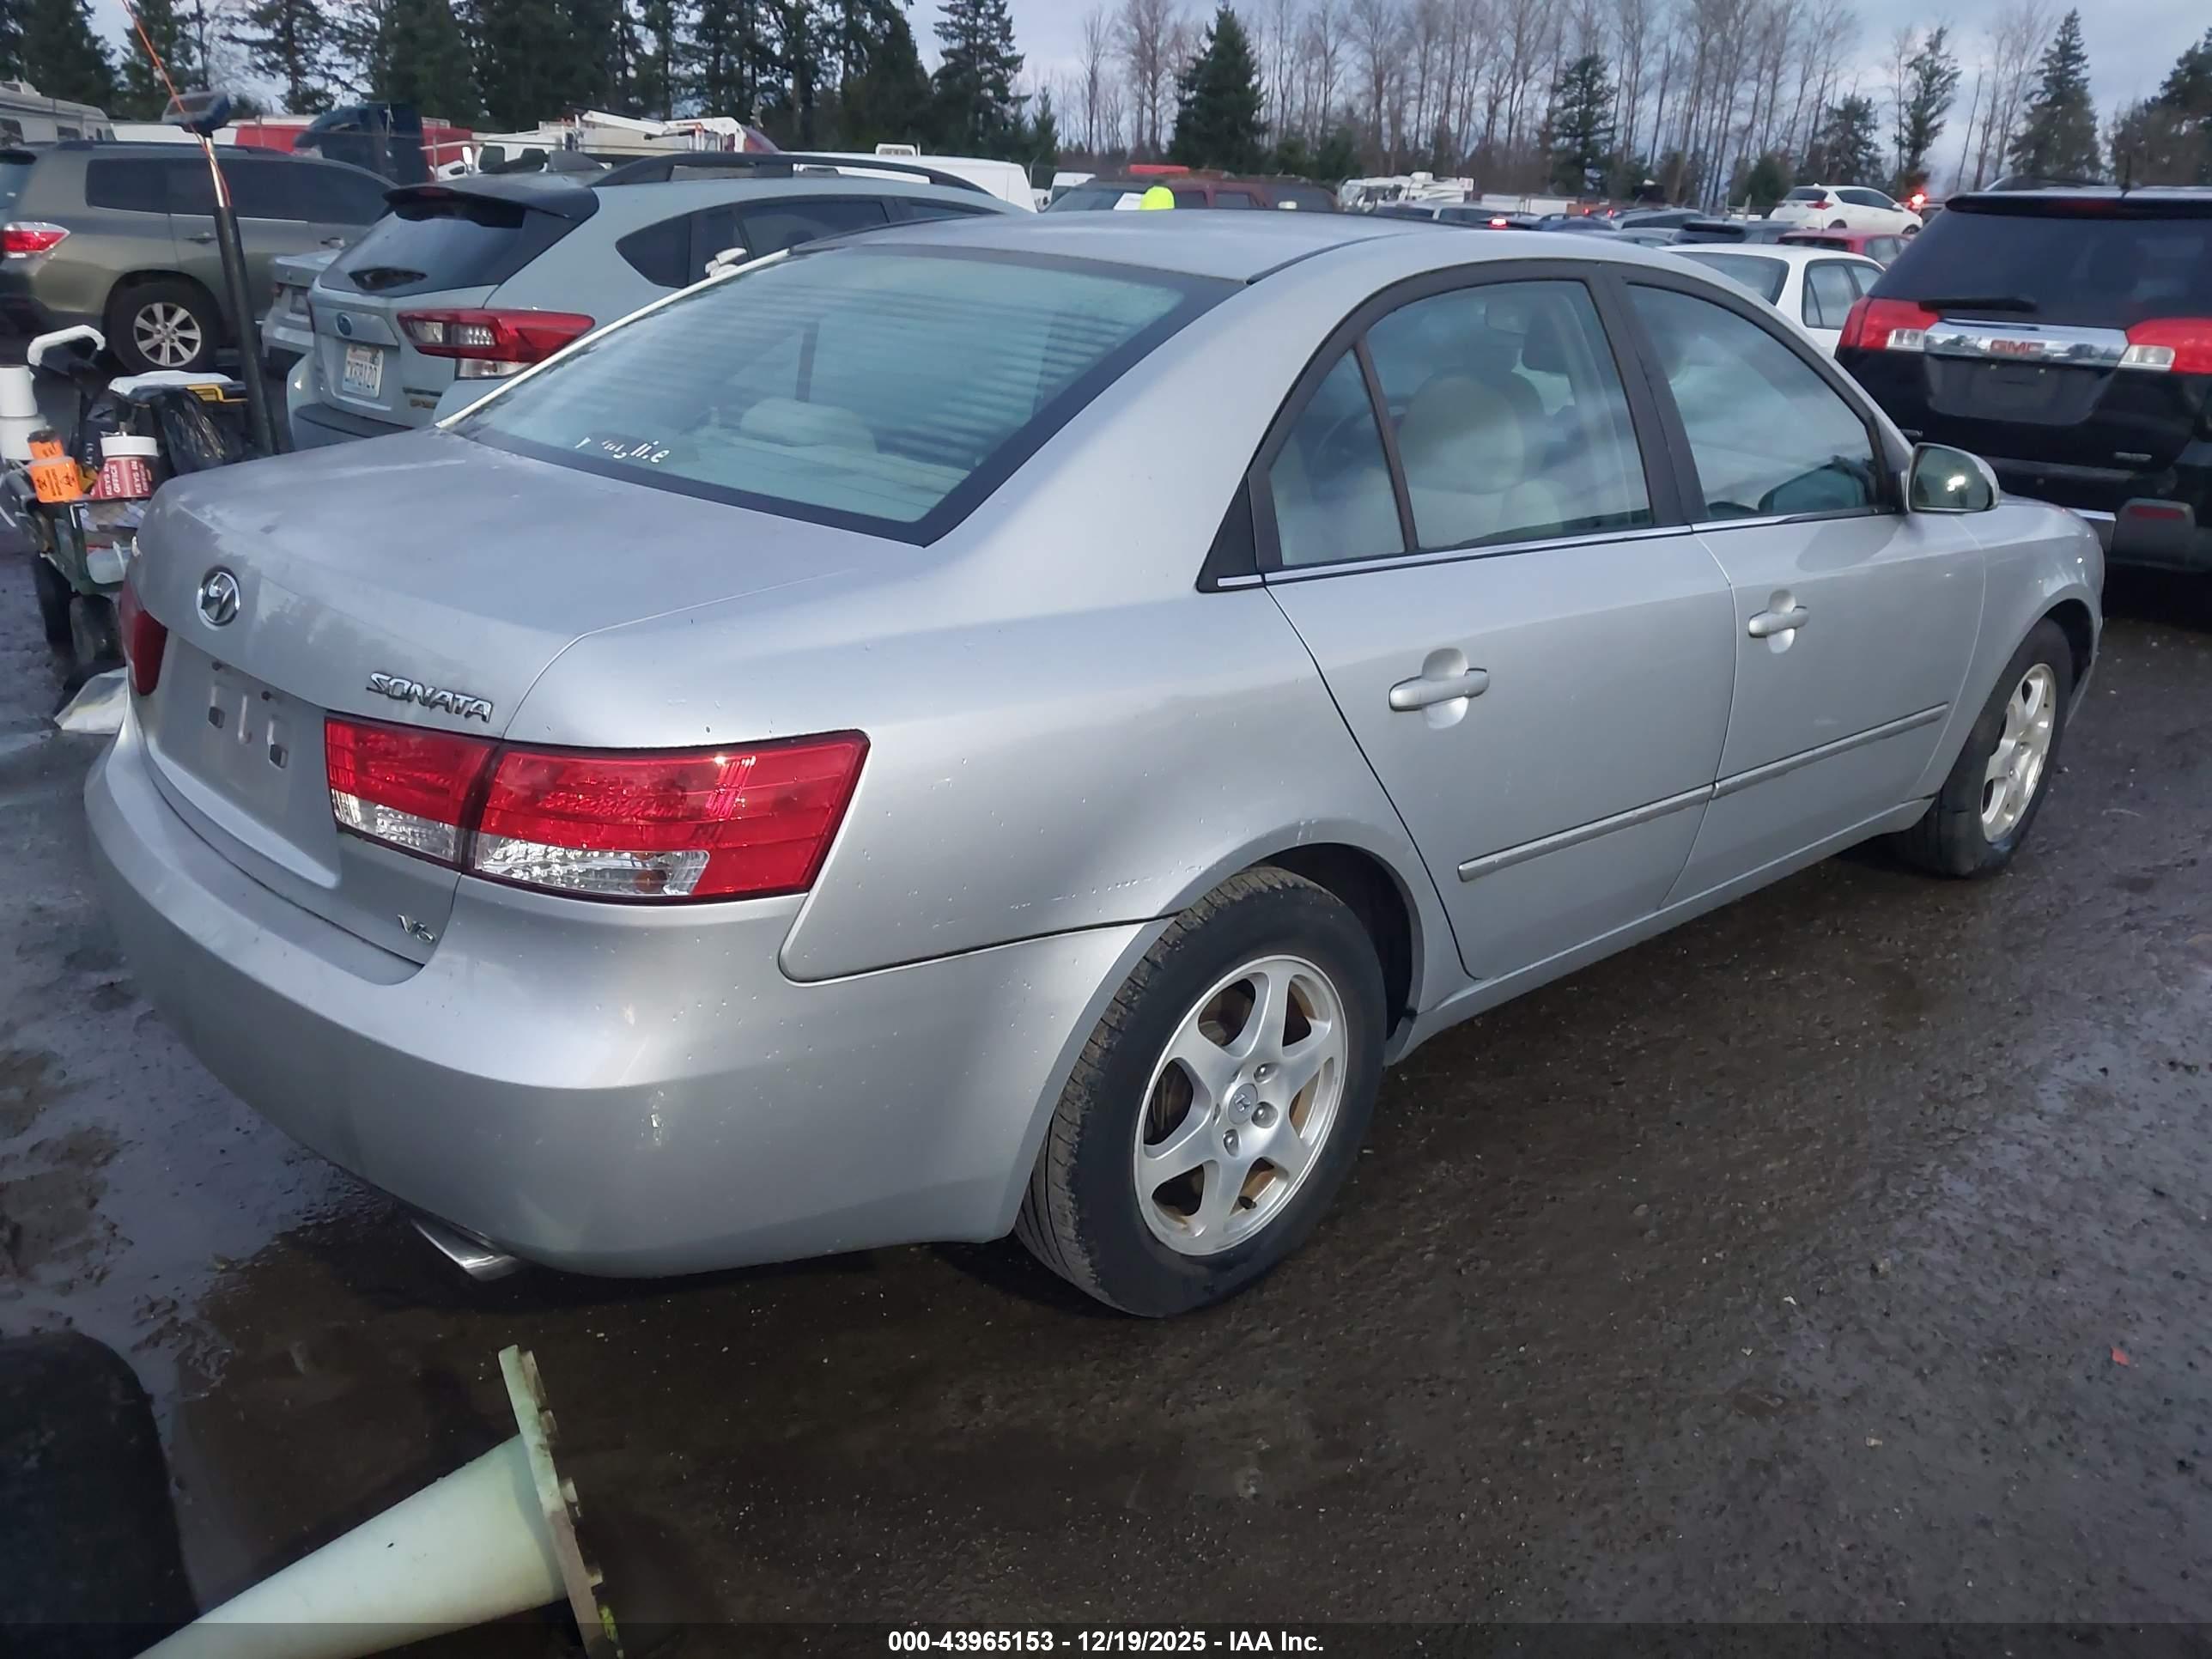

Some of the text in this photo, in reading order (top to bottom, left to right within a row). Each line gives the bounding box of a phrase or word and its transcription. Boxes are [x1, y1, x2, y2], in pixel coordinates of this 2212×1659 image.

[1990, 339, 2045, 356] GMC
[103, 473, 112, 495] KEYS
[109, 464, 121, 494] OFFICE
[131, 460, 143, 495] KEYS IN
[366, 672, 494, 723] SONATA
[398, 914, 436, 944] V6
